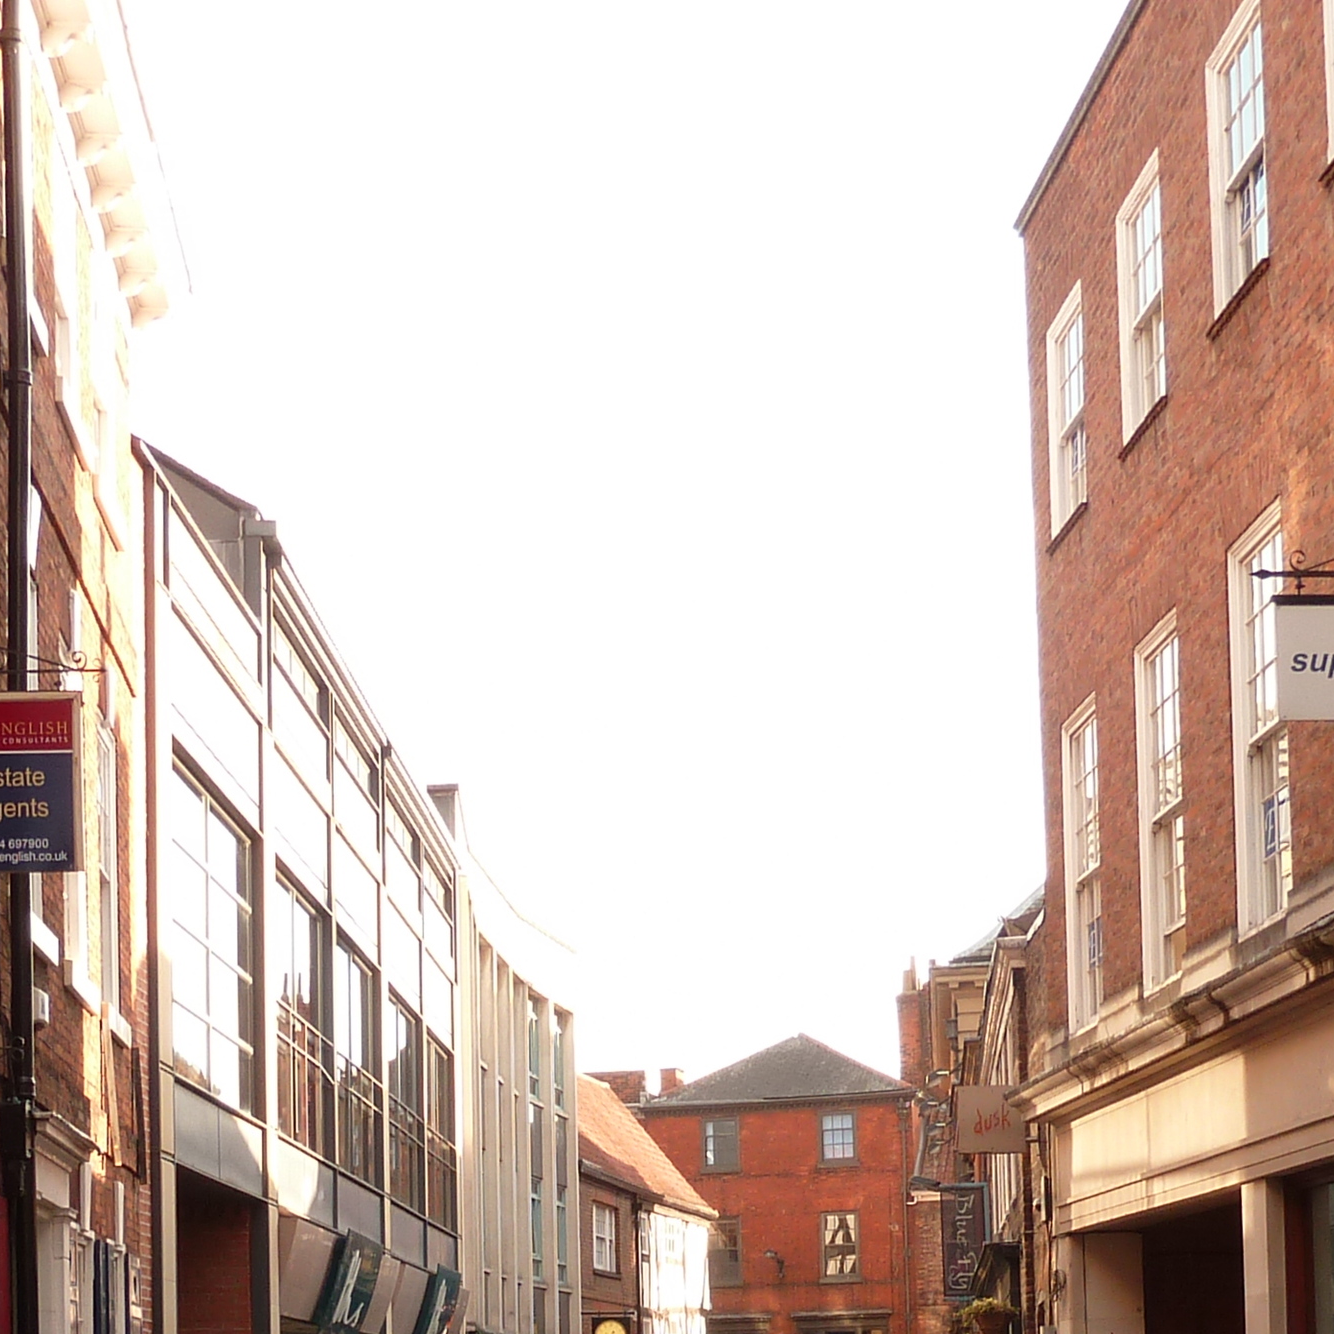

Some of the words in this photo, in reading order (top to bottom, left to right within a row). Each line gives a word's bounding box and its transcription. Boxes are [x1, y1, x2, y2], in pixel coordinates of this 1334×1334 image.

[2, 736, 69, 745] CONSULTANTS
[7, 838, 50, 850] 697900
[973, 1102, 1012, 1137] dusk
